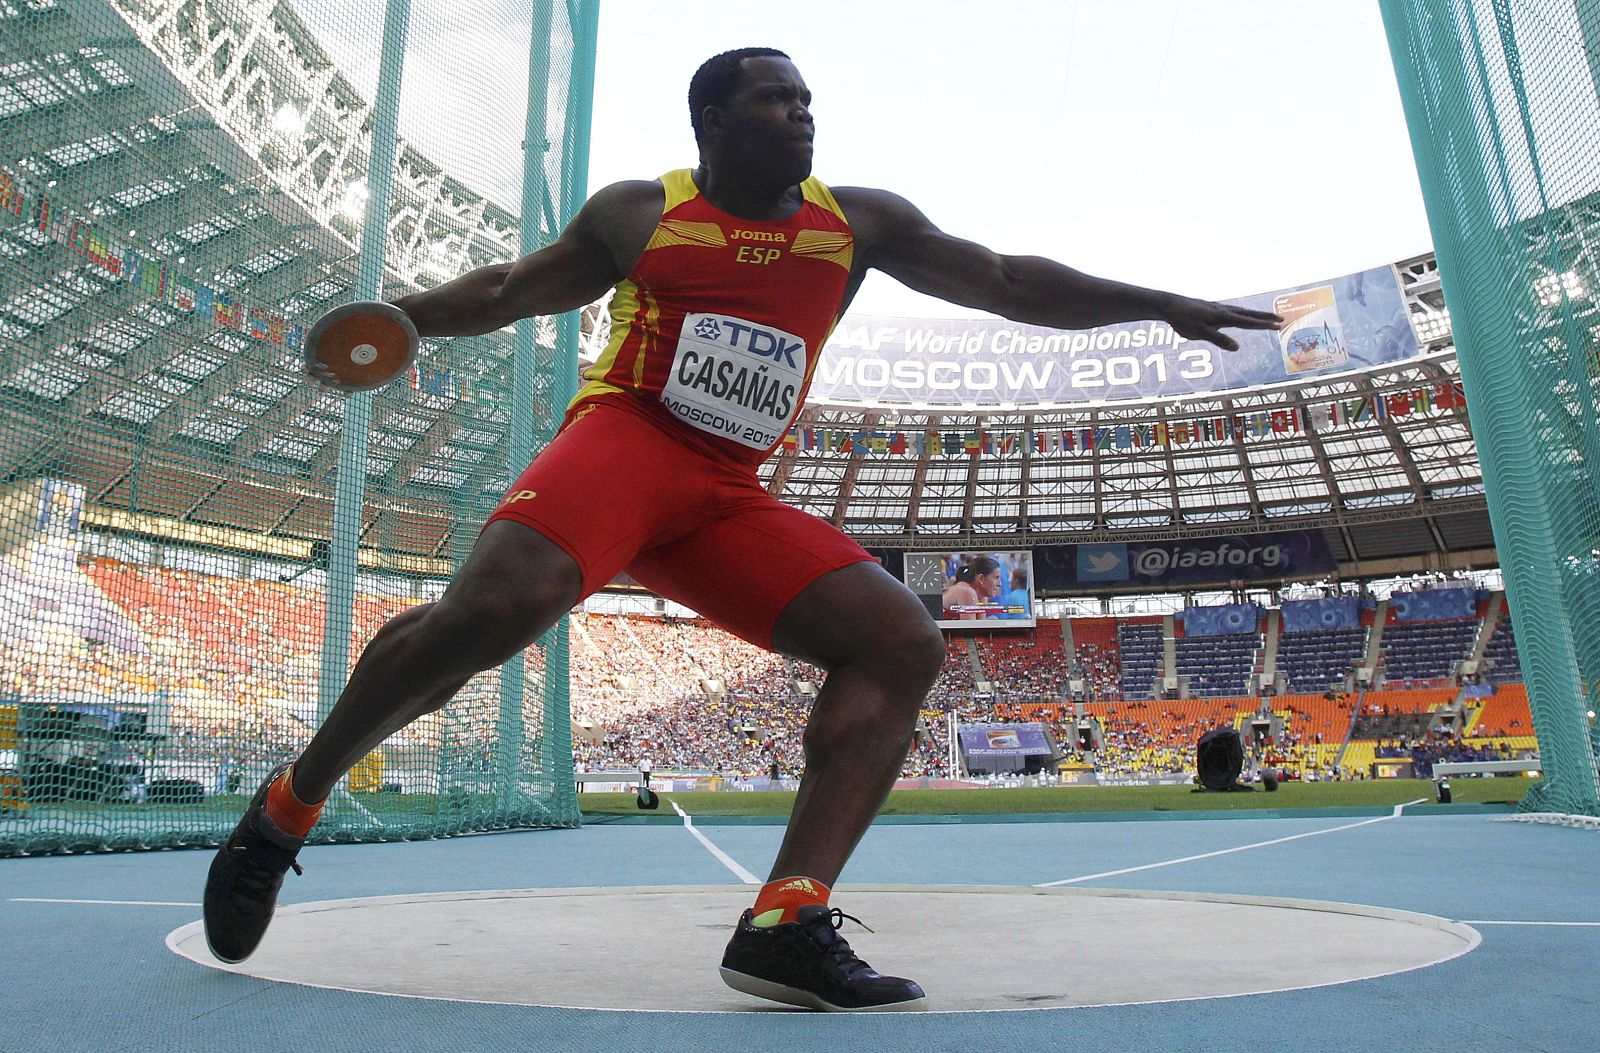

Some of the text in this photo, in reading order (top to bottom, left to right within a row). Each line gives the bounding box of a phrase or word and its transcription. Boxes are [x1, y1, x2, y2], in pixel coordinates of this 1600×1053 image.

[731, 229, 787, 243] Joma
[736, 246, 781, 265] ESP
[722, 320, 803, 370] TDK
[829, 323, 899, 351] AAF
[904, 328, 987, 354] World
[677, 350, 795, 421] CASAÑAS
[812, 348, 1215, 391] MOSCOW 2013
[663, 397, 777, 447] MOSCOW 2013
[1135, 544, 1281, 576] @iaaforg
